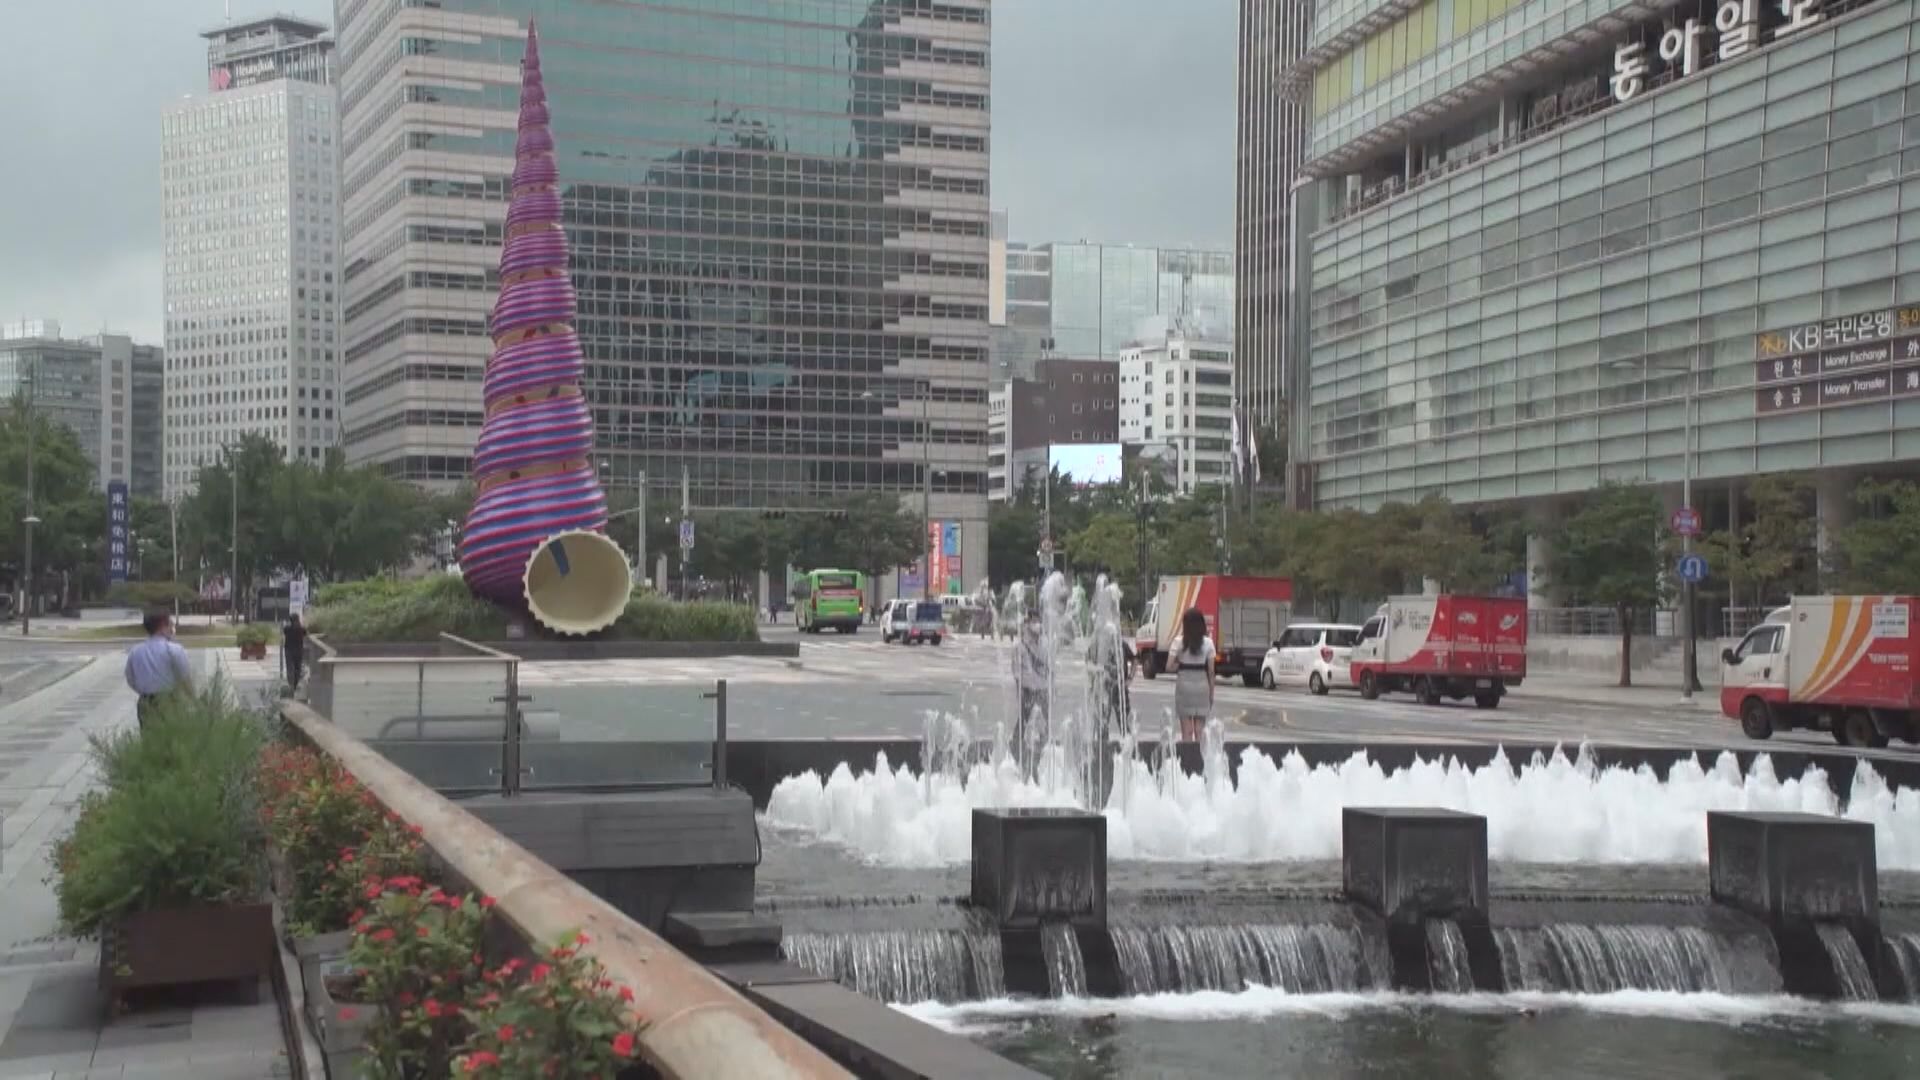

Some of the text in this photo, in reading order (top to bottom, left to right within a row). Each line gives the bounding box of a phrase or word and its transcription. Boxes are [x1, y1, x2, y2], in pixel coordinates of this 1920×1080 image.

[1825, 349, 1887, 367] Money Exchange
[1825, 378, 1886, 397] Money Transfer
